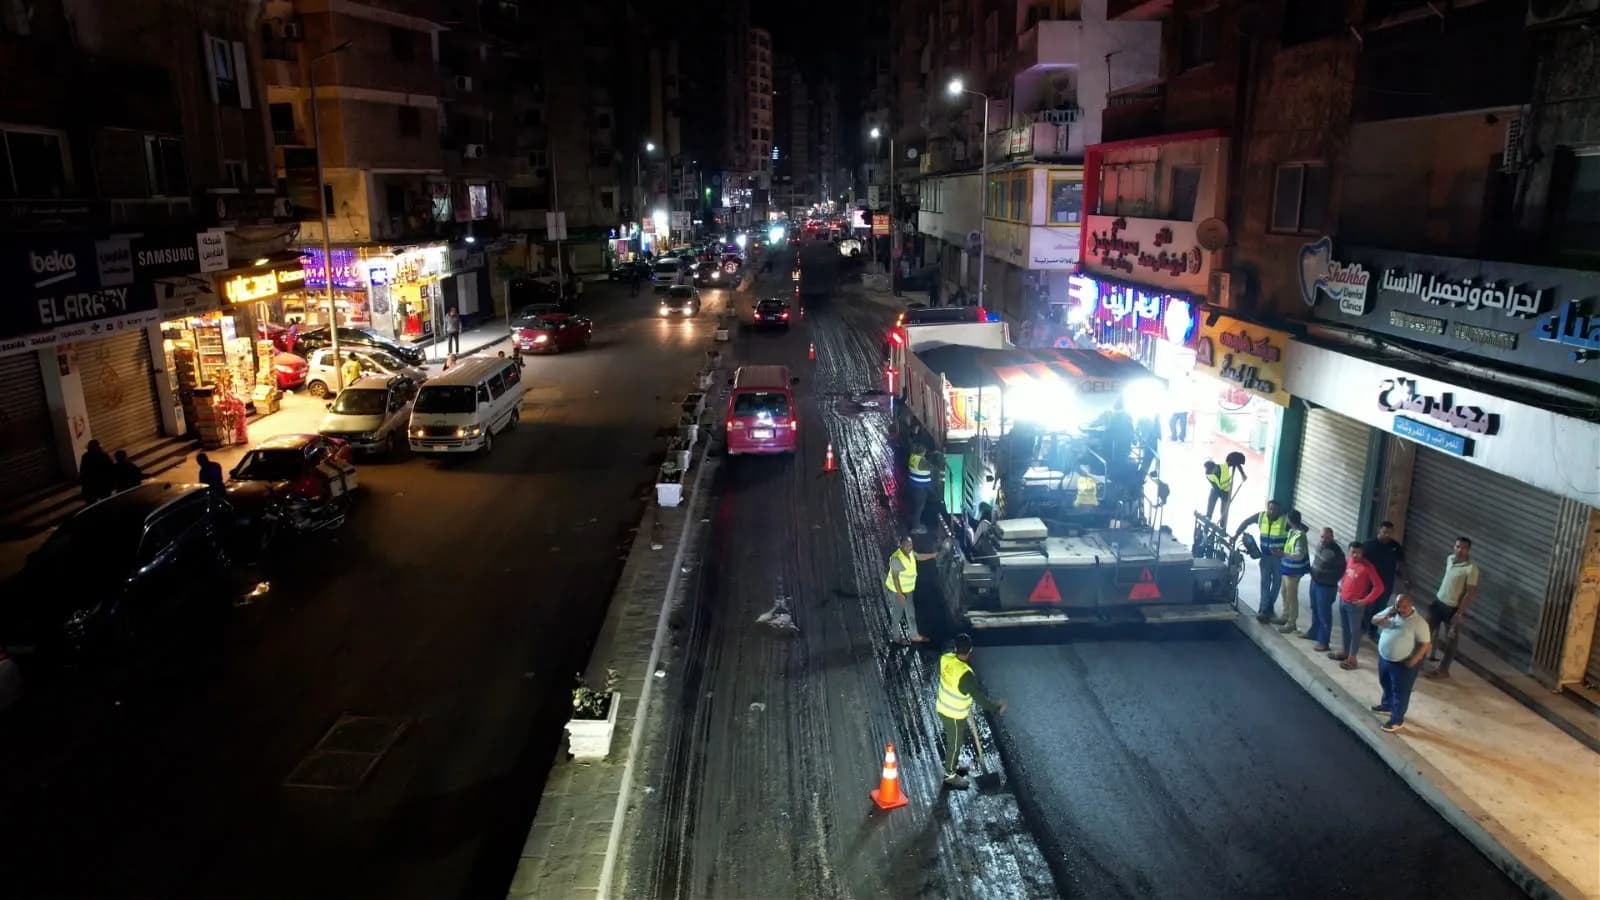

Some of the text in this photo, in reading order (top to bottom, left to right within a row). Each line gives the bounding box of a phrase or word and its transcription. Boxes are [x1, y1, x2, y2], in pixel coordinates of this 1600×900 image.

[28, 249, 76, 273] beko
[138, 247, 195, 267] SAMSUNG
[1325, 262, 1368, 286] Shahba
[1420, 275, 1482, 311] وتجميل
[1481, 282, 1542, 319] لجراحة
